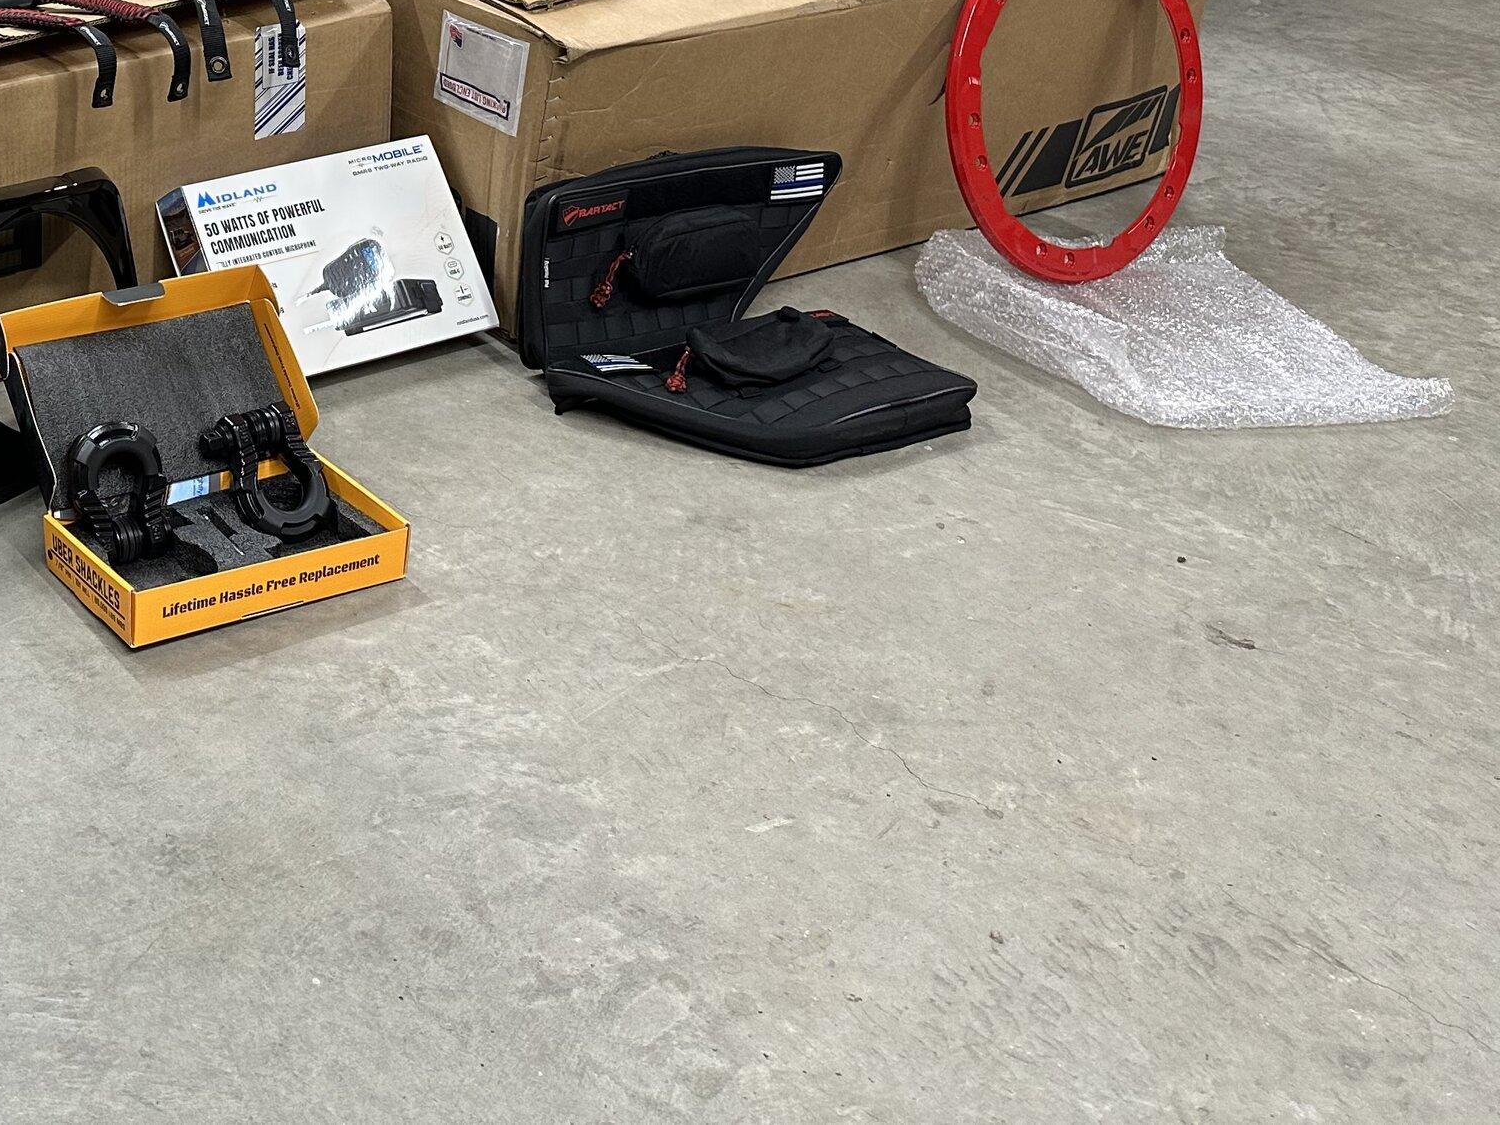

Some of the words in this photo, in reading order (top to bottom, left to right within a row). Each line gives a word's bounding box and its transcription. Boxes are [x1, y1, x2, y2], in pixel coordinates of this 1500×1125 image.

[348, 155, 372, 165] MICRO
[372, 144, 423, 163] MOBILE
[352, 167, 373, 177] GMRS
[373, 160, 405, 172] TWO-WAY
[406, 155, 429, 165] RADIO
[1077, 130, 1147, 180] AWE
[197, 182, 278, 209] MIDLAND
[578, 199, 626, 218] BARTACT
[203, 221, 220, 238] 50
[220, 213, 256, 234] WATTS
[257, 209, 270, 226] OF
[272, 197, 326, 223] POWERFUL
[210, 222, 297, 256] COMMUNICATION
[232, 252, 262, 265] INTEGRATED
[262, 246, 285, 259] CONTROL
[285, 239, 317, 253] MICROPHONE
[51, 532, 74, 568] UBER
[74, 554, 121, 611] SHACKLES
[161, 594, 216, 620] Lifetime
[219, 583, 264, 606] Hassle
[266, 573, 296, 595] Free
[299, 553, 381, 588] Replacement
